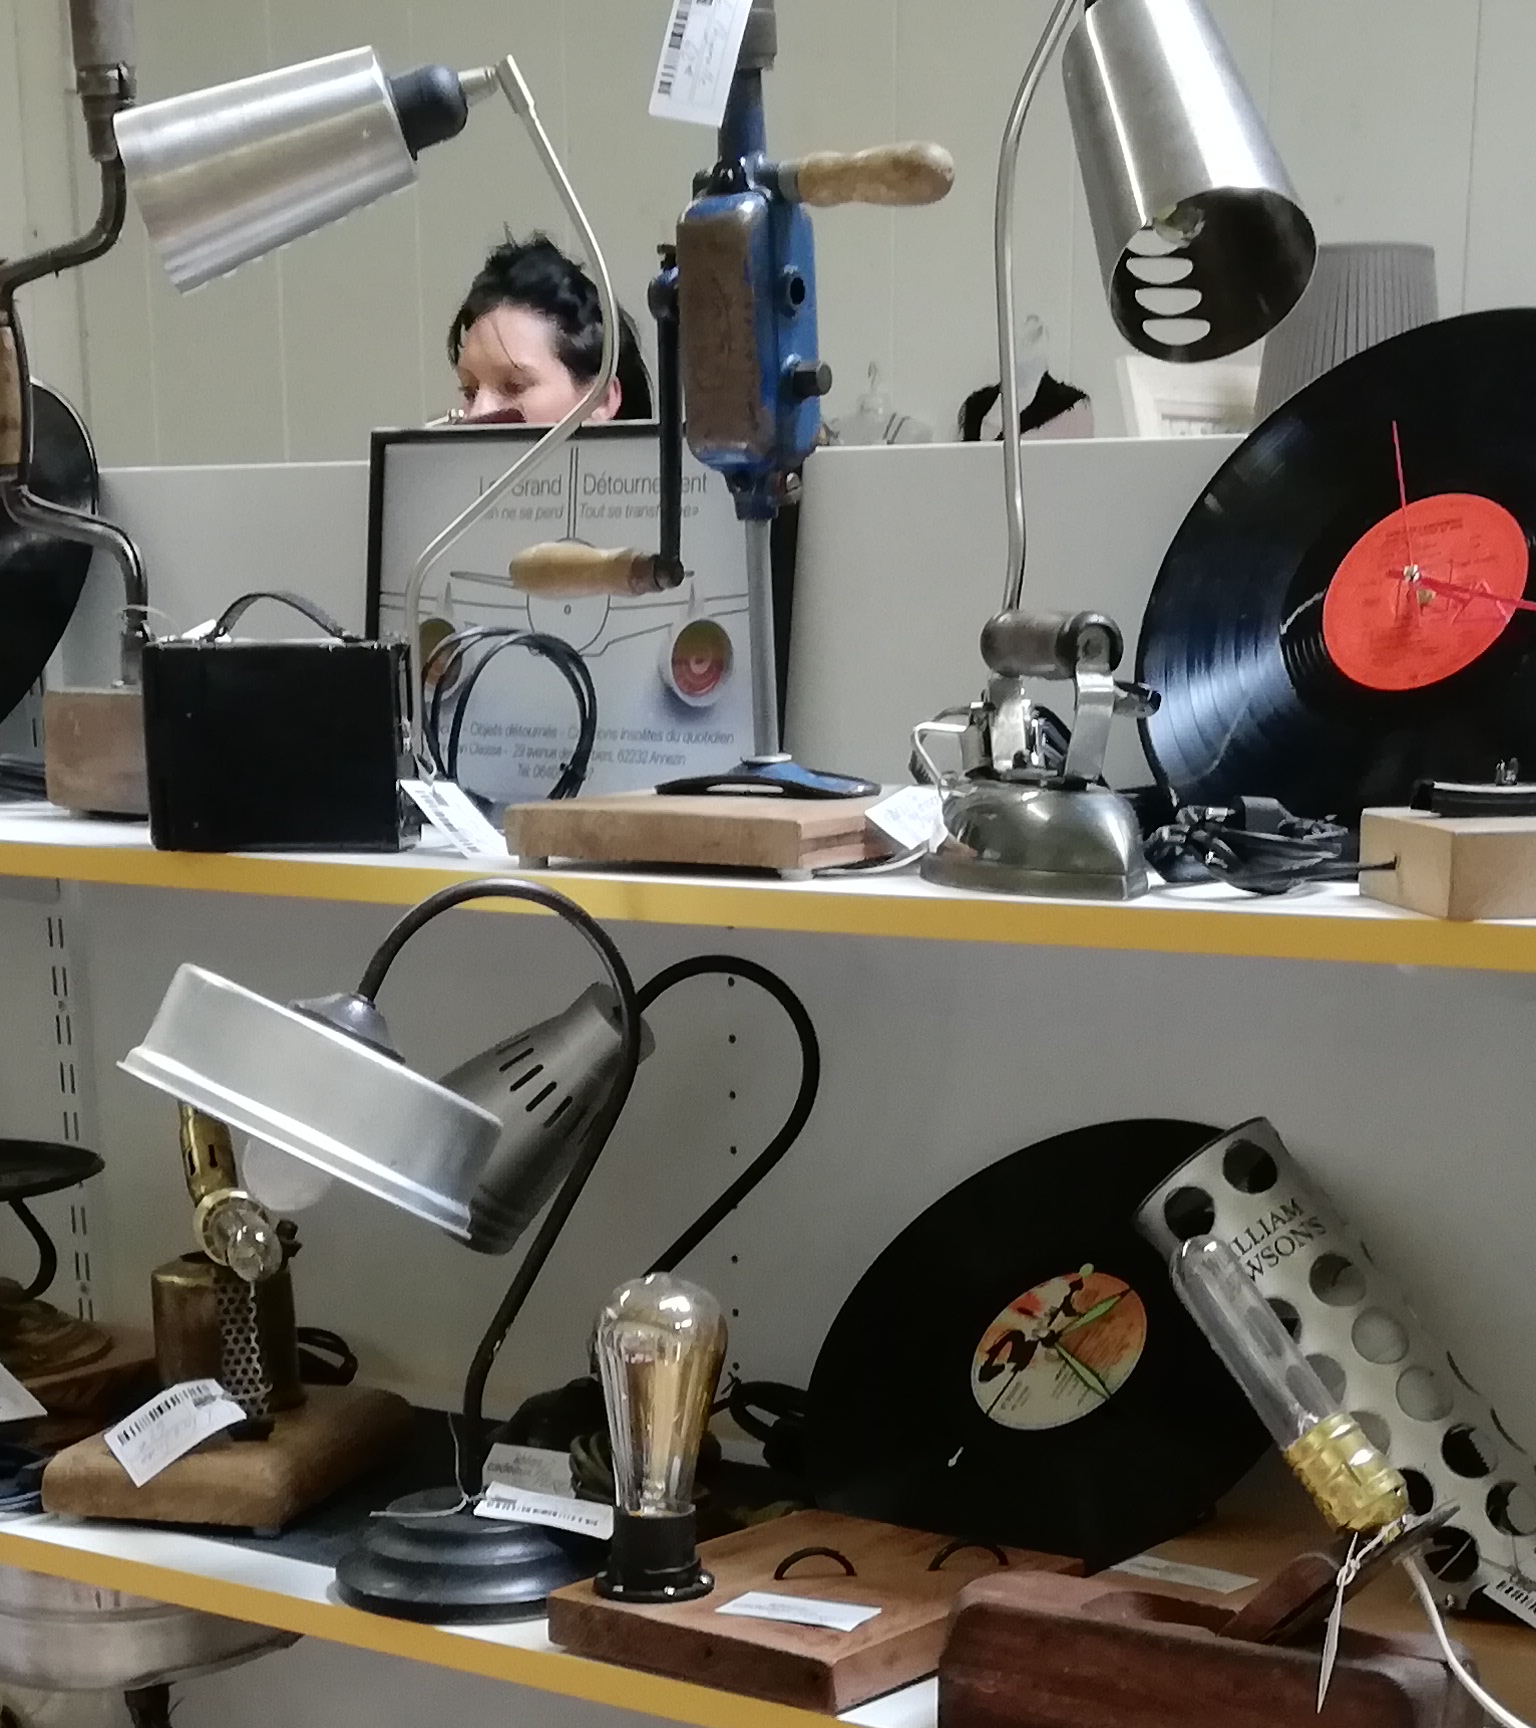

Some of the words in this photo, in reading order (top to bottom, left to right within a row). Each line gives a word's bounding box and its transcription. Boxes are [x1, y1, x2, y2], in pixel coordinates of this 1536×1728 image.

[583, 471, 707, 496] Détourneent
[1229, 1198, 1304, 1256] LLIAM
[1245, 1216, 1326, 1282] WSONS
